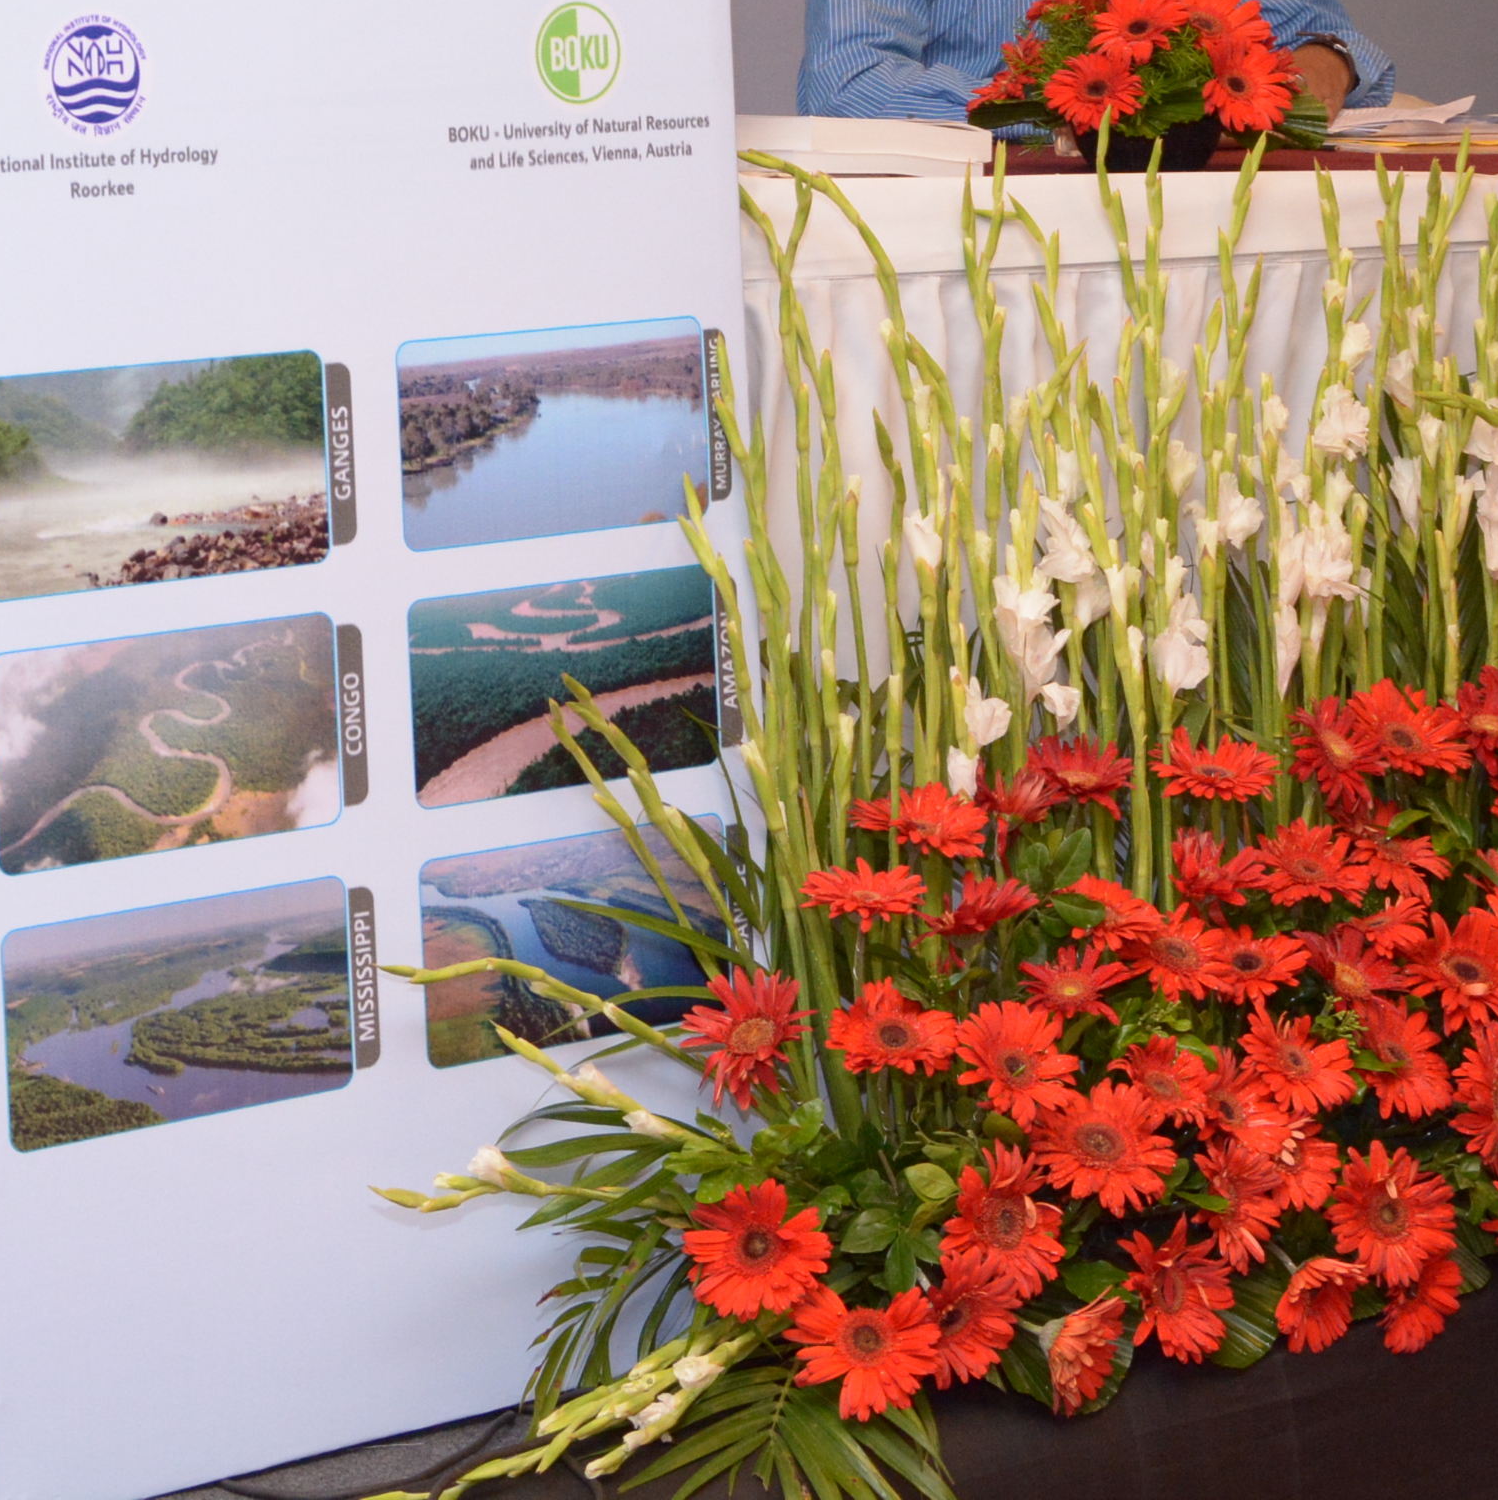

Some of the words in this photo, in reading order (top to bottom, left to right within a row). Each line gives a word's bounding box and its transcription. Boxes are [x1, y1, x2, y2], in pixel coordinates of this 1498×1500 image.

[550, 34, 609, 72] BOKU
[448, 125, 489, 143] BOKU
[503, 121, 571, 140] University
[575, 119, 589, 135] of
[593, 116, 642, 134] Natural
[646, 114, 710, 131] Resources
[51, 151, 115, 170] Institute
[121, 149, 136, 166] of
[140, 147, 218, 168] Hydrology
[470, 153, 495, 171] and
[499, 150, 524, 169] Life
[528, 149, 589, 168] Sciences,
[592, 145, 642, 162] Vienna,
[646, 141, 692, 159] Austria
[71, 180, 134, 199] Roorkee
[333, 405, 352, 501] GANGES
[344, 671, 363, 759] CONGO
[353, 909, 374, 1043] MISSISSIPPI
